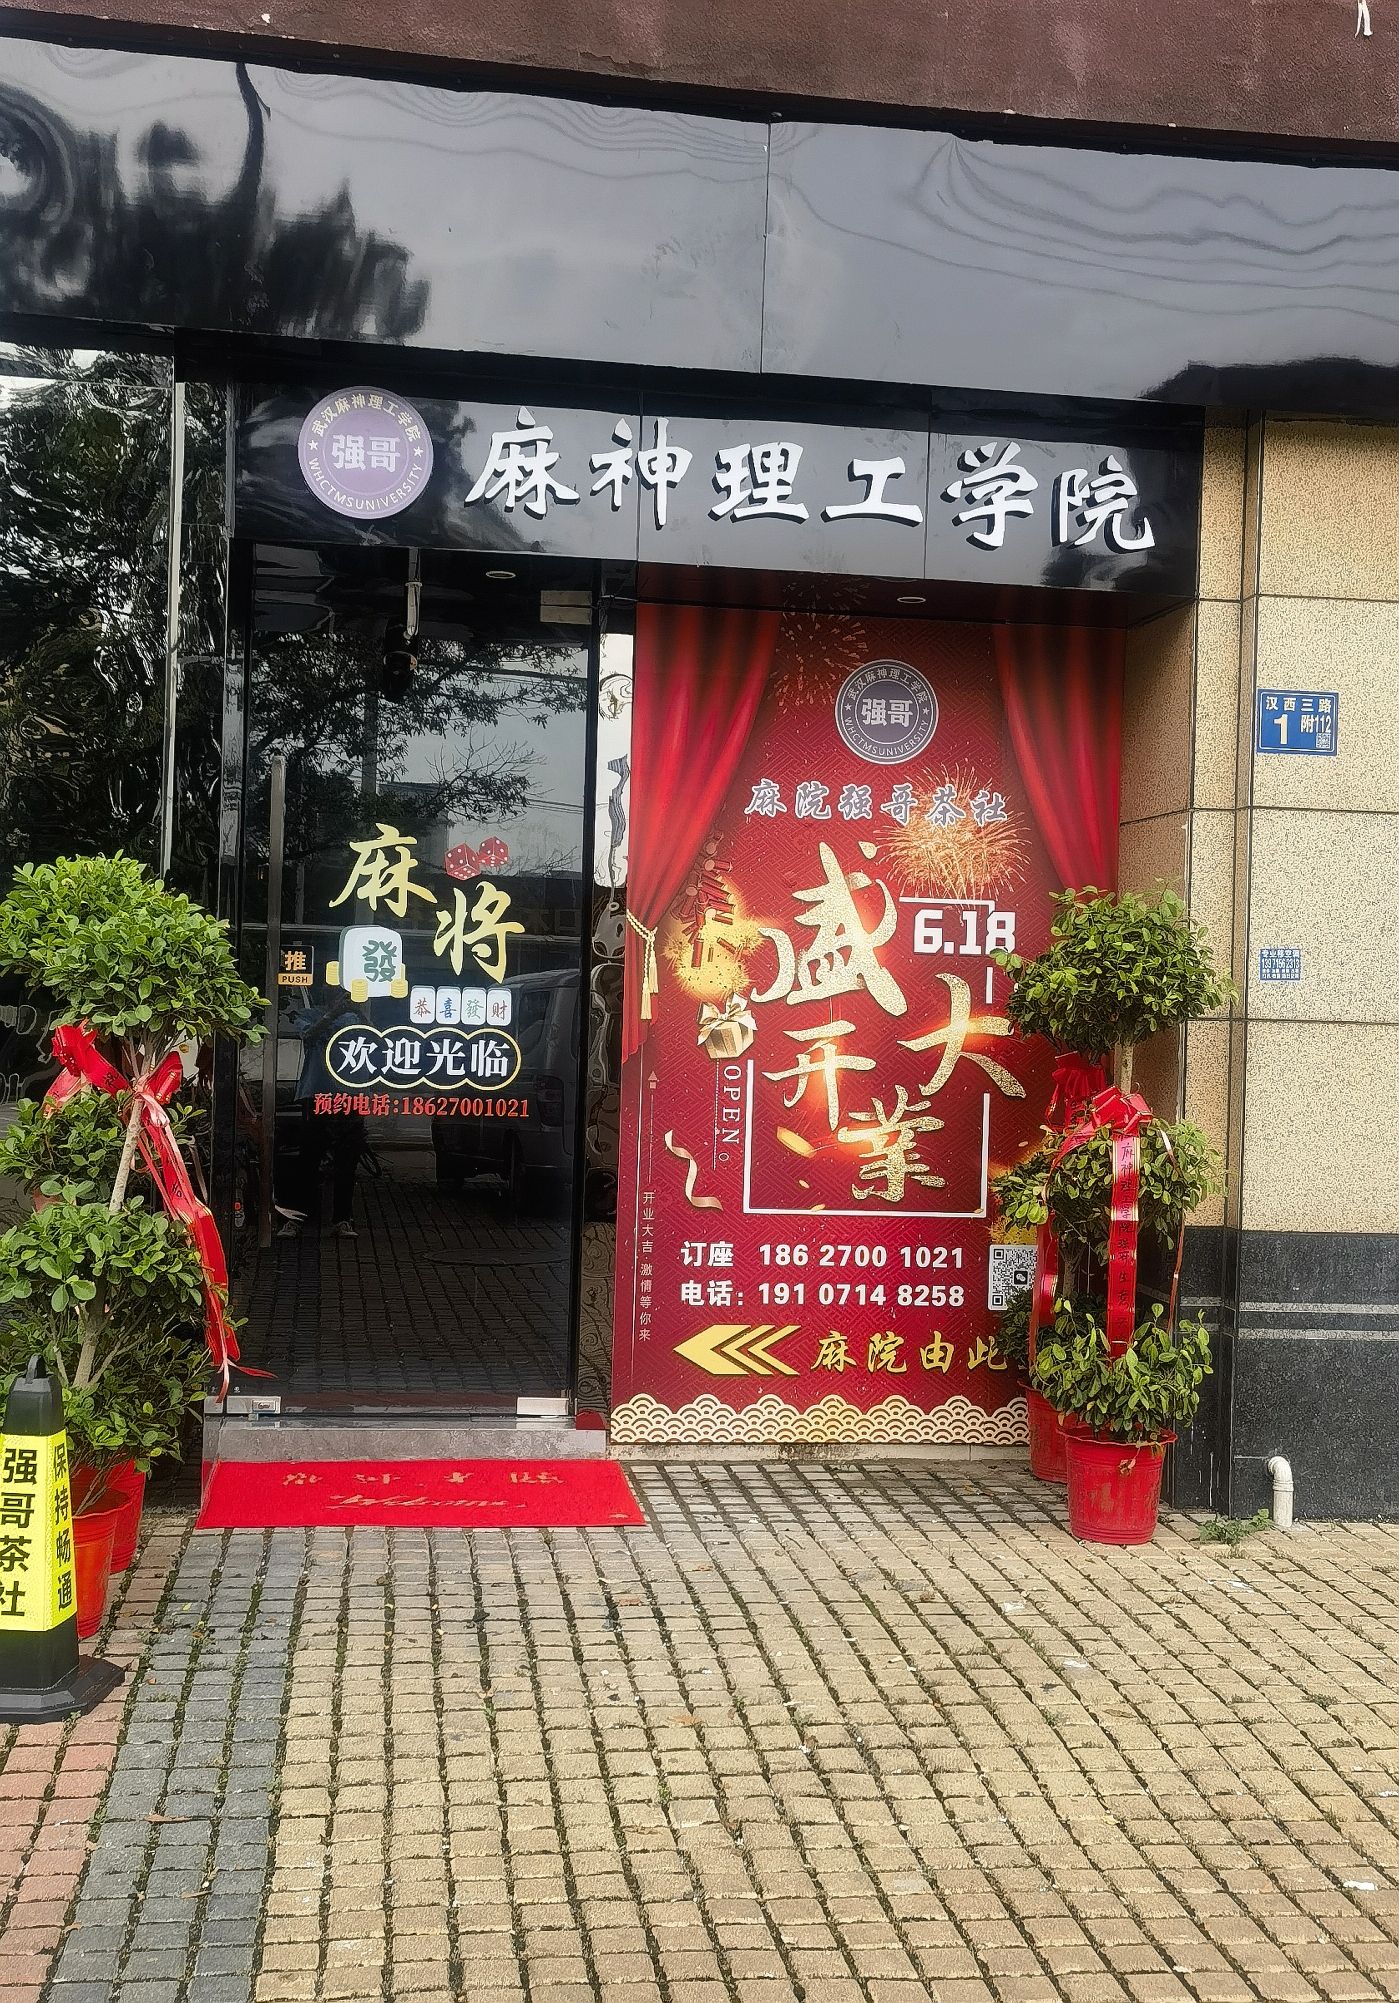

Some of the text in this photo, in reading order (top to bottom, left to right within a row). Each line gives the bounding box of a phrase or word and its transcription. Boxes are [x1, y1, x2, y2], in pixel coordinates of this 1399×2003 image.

[311, 393, 421, 442] 武汉麻神理工学院
[332, 434, 401, 473] 强哥
[308, 457, 423, 511] WHCTMSUNIVERSITY
[465, 405, 1156, 553] 麻神理工学院
[847, 668, 929, 704] 武汉麻神理工学院
[1265, 696, 1332, 714] 汉西三路
[861, 698, 914, 728] 强哥
[1273, 714, 1332, 745] 1 附112
[844, 716, 930, 757] WHCTMSUNIVERSITY
[744, 778, 1008, 826] 麻院强哥茶社
[329, 823, 525, 984] 麻将
[912, 909, 1016, 955] 6.18
[281, 975, 309, 985] PUSH
[284, 950, 307, 972] 推
[362, 939, 398, 982] 發
[336, 1036, 511, 1077] 欢迎光临
[680, 1241, 964, 1269] 订座 186 2700 1021
[681, 1279, 965, 1307] 电话: 191 0714 8258
[0, 1448, 38, 1617] 强哥茶社
[53, 1443, 73, 1612] 保持畅通
